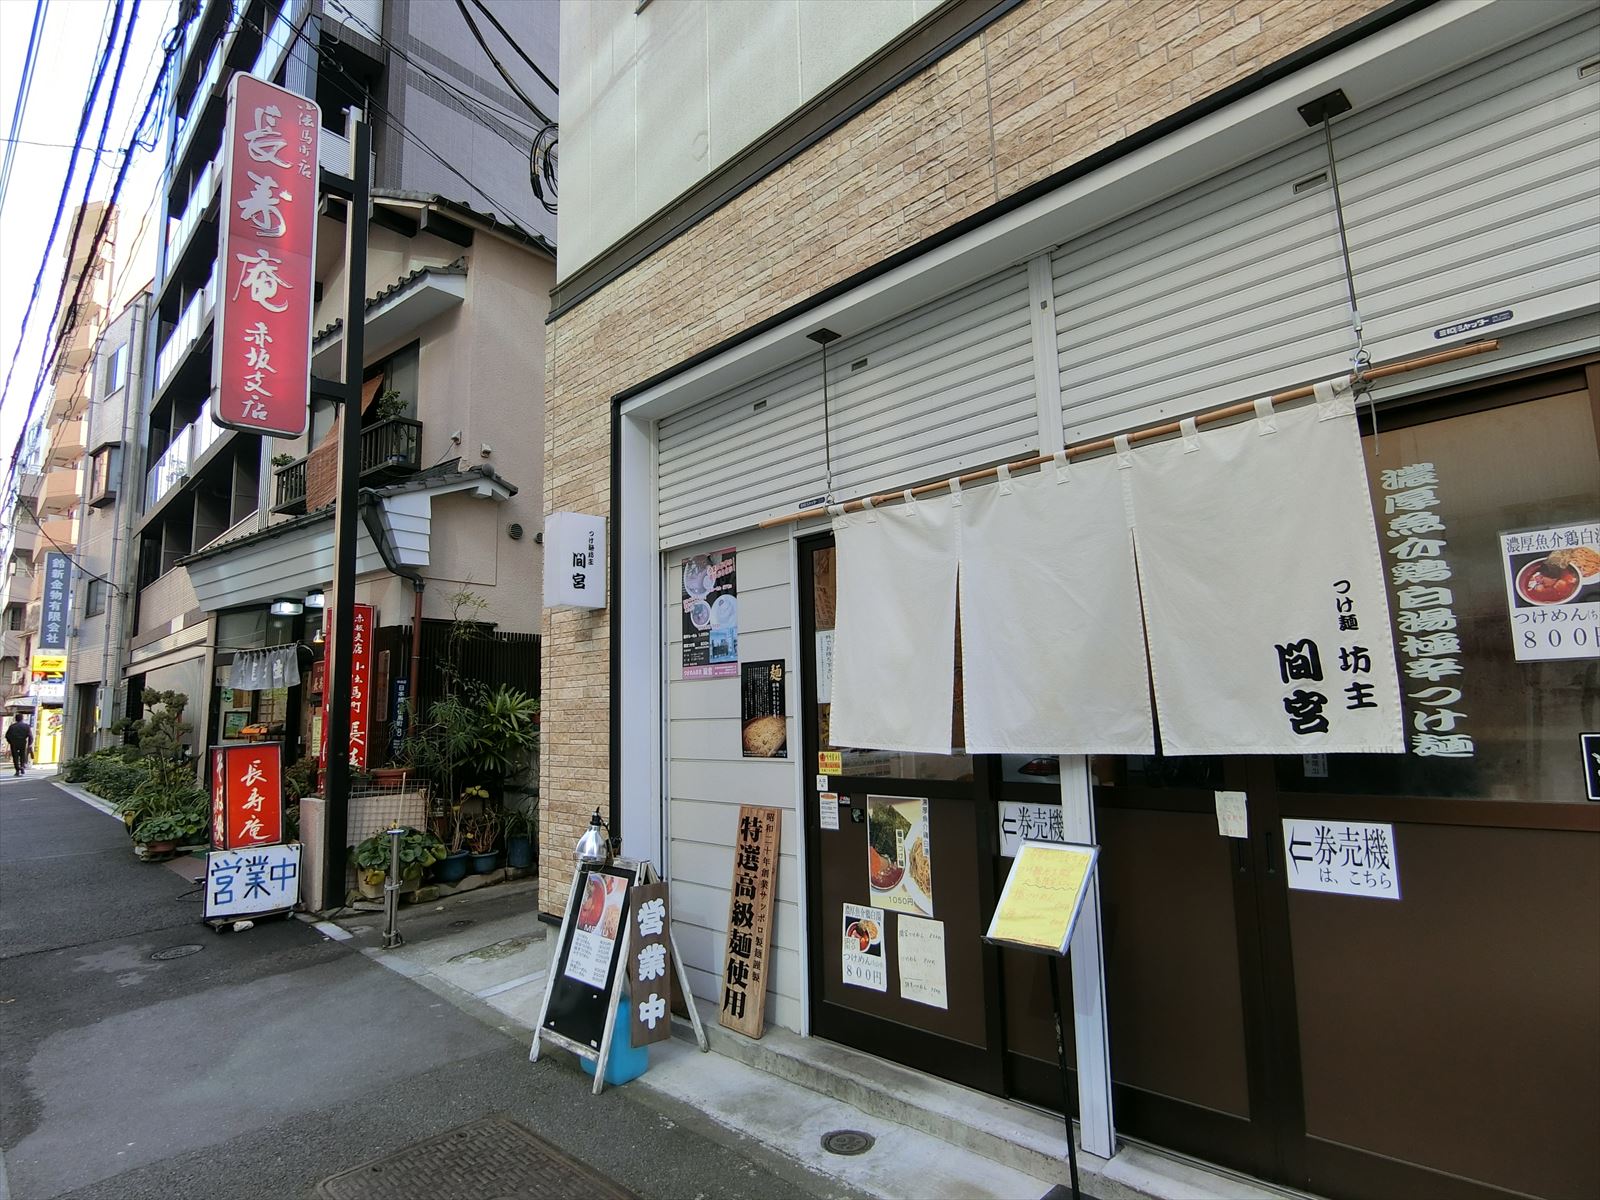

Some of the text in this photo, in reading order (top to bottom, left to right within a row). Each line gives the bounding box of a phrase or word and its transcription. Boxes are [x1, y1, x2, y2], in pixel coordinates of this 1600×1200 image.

[232, 105, 294, 421] 長寿庵 赤坂支店
[572, 552, 586, 590] 間宮
[1513, 607, 1587, 624] つけめん
[1333, 580, 1378, 709] つけ麺 坊主
[770, 663, 782, 682] 麺
[1274, 638, 1330, 735] 間宮
[239, 760, 272, 840] 長寿庵
[1018, 806, 1064, 841] 券売機
[1314, 825, 1391, 870] 券売機
[211, 855, 297, 905] 営業中
[888, 896, 915, 906] 1050円
[722, 815, 763, 1020] 特選高級麺使用
[637, 897, 667, 1030] 営業中
[846, 966, 882, 985] 800円
